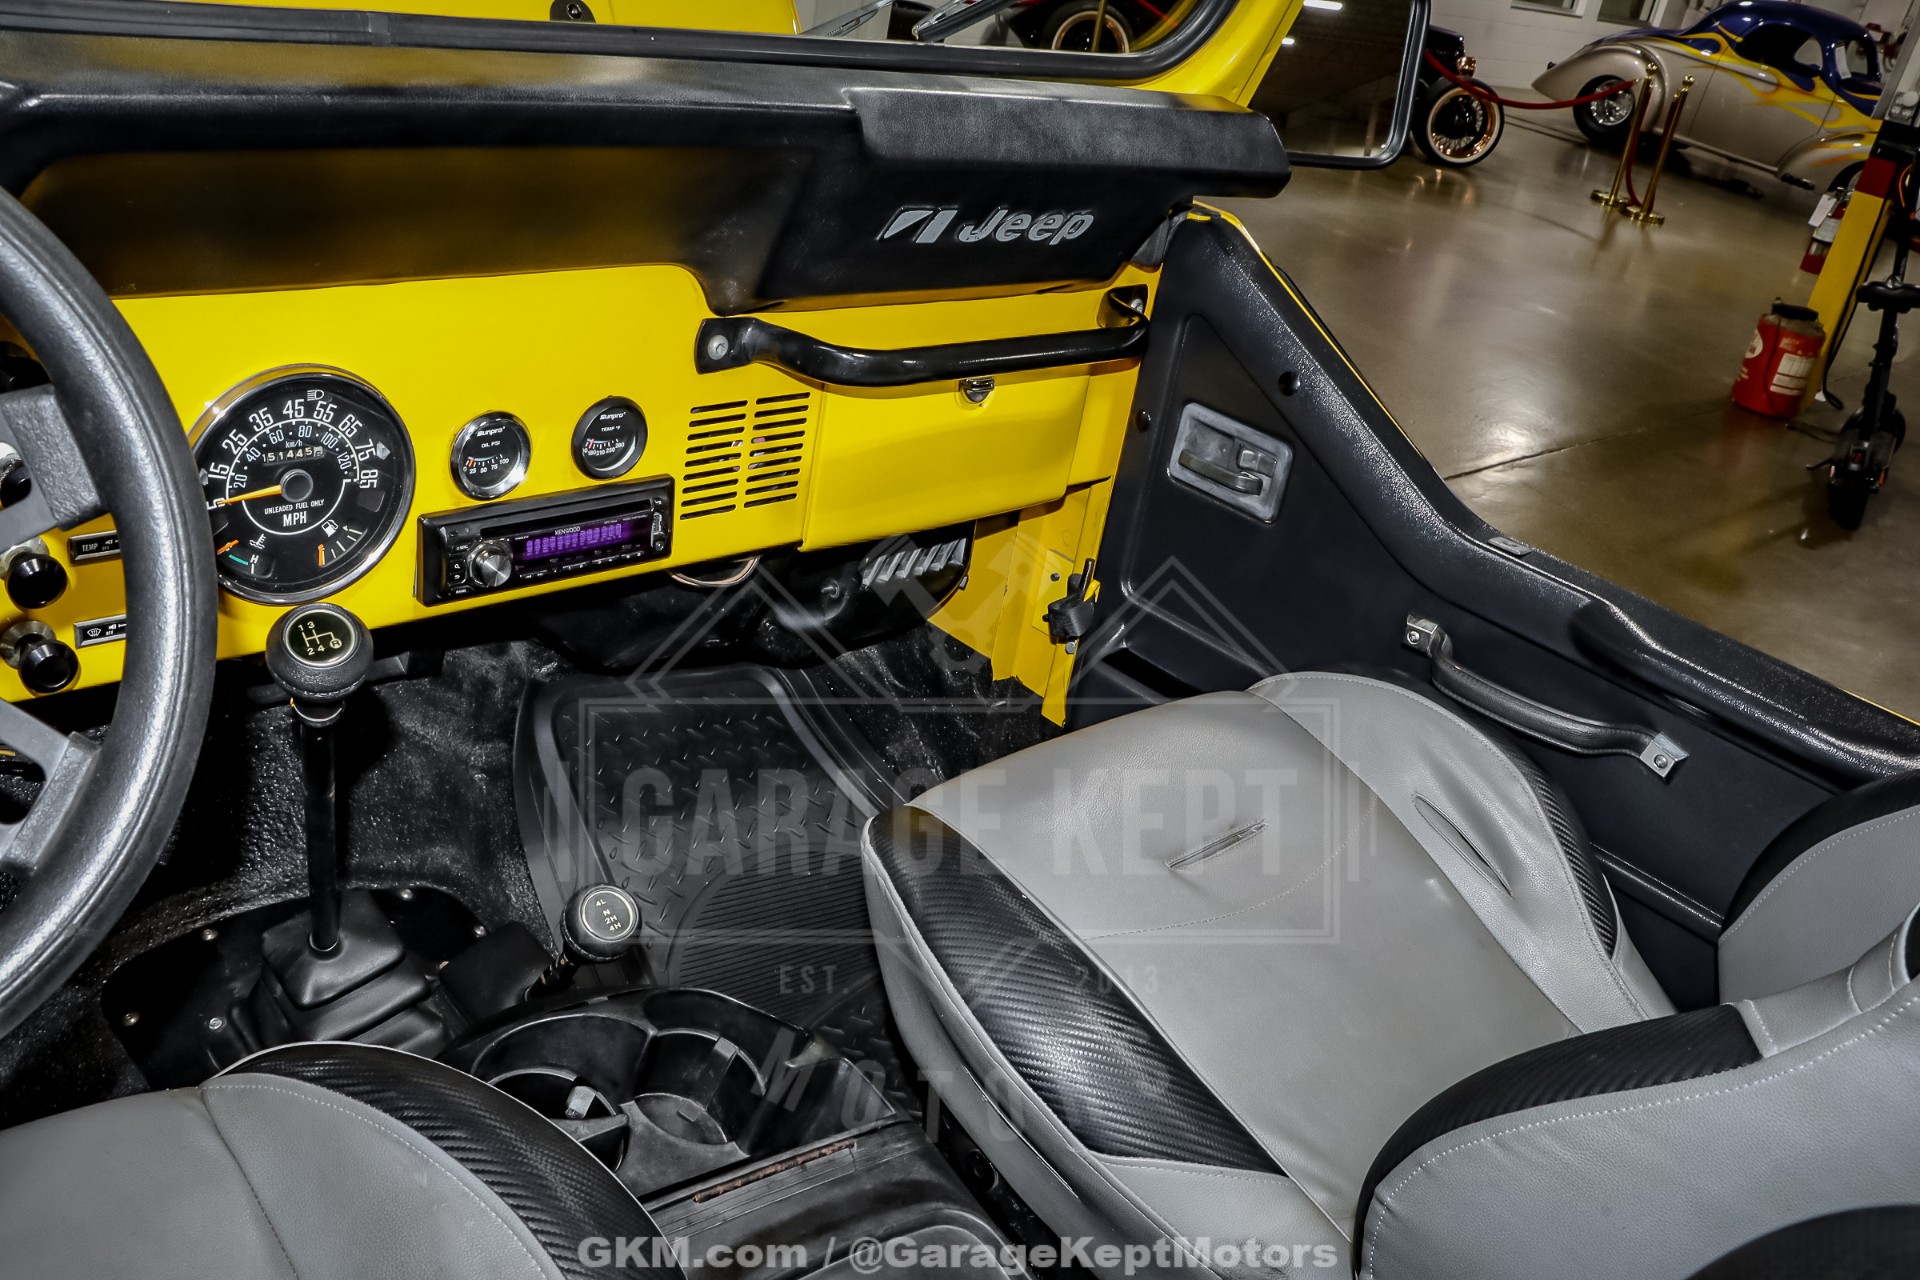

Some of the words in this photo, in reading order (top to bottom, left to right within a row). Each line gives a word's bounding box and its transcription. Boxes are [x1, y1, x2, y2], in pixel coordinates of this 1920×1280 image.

[957, 207, 1095, 246] Jeep
[282, 398, 305, 418] 45
[313, 400, 338, 422] 55
[249, 407, 274, 432] 35
[338, 413, 363, 438] 65
[222, 429, 248, 455] 25
[285, 438, 303, 448] km/h
[355, 438, 376, 462] 75
[233, 474, 248, 489] 20
[246, 447, 262, 463] 40
[269, 429, 285, 445] 60
[298, 425, 312, 438] 80
[320, 431, 339, 450] 100
[336, 451, 352, 471] 120
[207, 462, 231, 480] 15
[359, 469, 378, 489] 85
[264, 504, 293, 515] UNLEADED
[295, 501, 309, 510] FUEL
[311, 499, 324, 508] ONLY
[282, 511, 307, 527] MPH
[554, 526, 581, 536] KENWOOD
[82, 543, 98, 552] TEMP
[307, 621, 315, 629] 3
[307, 647, 315, 656] 2
[317, 644, 326, 652] 4
[605, 915, 617, 924] 2H
[609, 922, 621, 931] 4H
